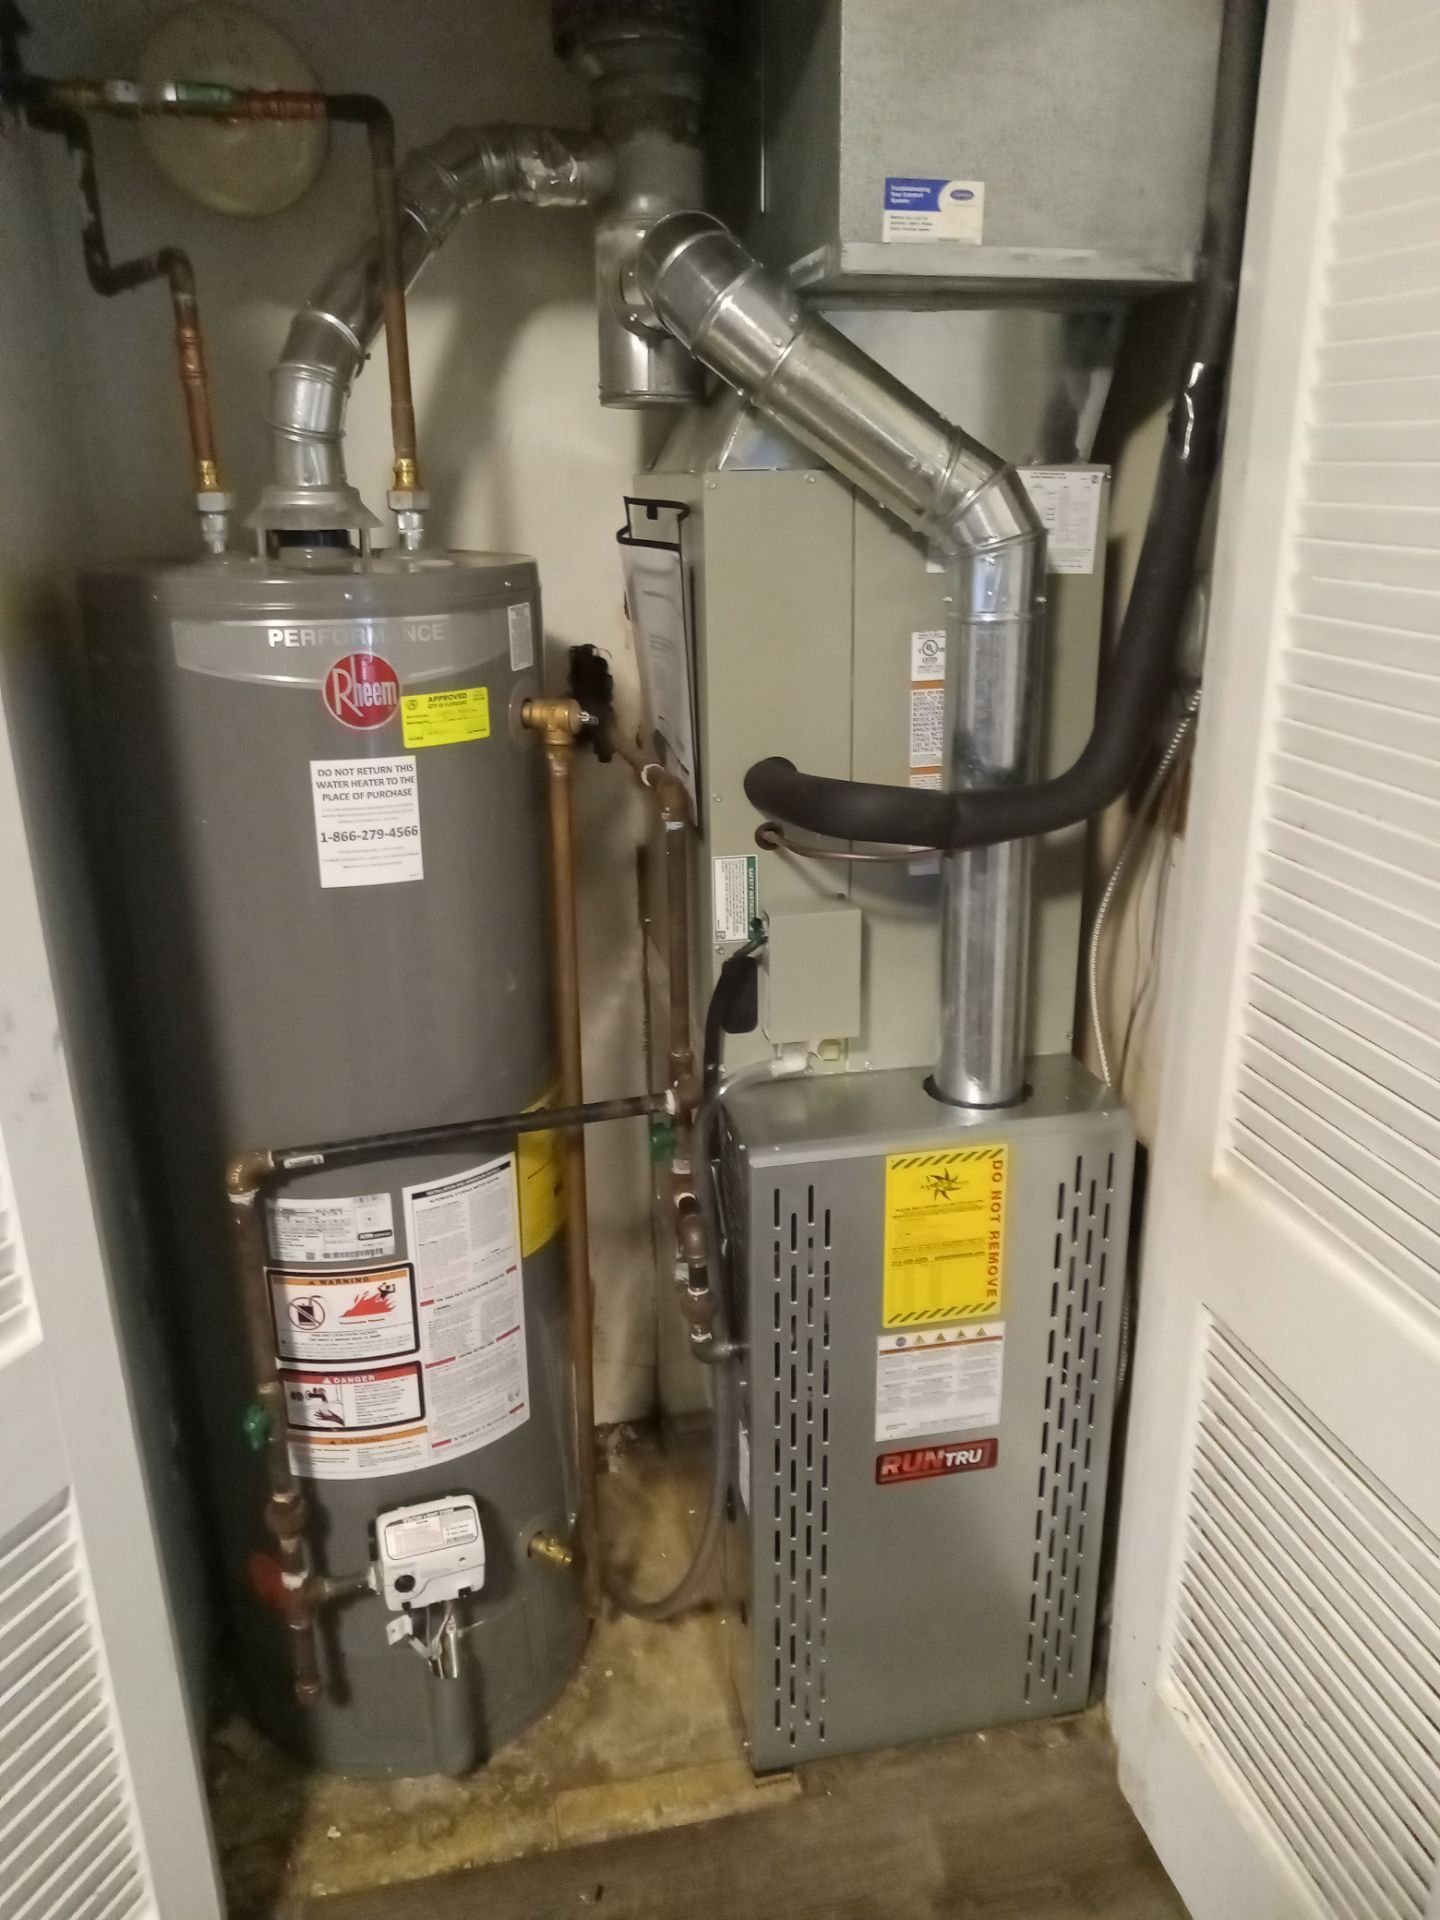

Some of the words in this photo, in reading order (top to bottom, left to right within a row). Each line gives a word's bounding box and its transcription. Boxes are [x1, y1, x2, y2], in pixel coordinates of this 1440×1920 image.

[267, 622, 445, 648] PERFORMNCE
[332, 655, 397, 717] Rheem
[428, 692, 467, 703] APPROVED
[317, 768, 332, 777] DO
[334, 767, 354, 777] NOT
[356, 765, 392, 776] RETURN
[394, 763, 414, 773] THIS
[316, 780, 349, 790] WATER
[350, 778, 385, 788] HEATER
[386, 777, 398, 786] TO
[399, 775, 415, 784] THE
[322, 792, 350, 801] PLACE
[352, 791, 364, 800] OF
[366, 787, 413, 800] PURCHASE
[320, 825, 419, 843] 1-866-279-4566
[992, 1160, 1003, 1183] DO
[990, 1190, 1002, 1223] NOT
[986, 1230, 1000, 1298] REMOVE
[319, 1276, 369, 1286] WARNING
[333, 1374, 376, 1385] DANGER
